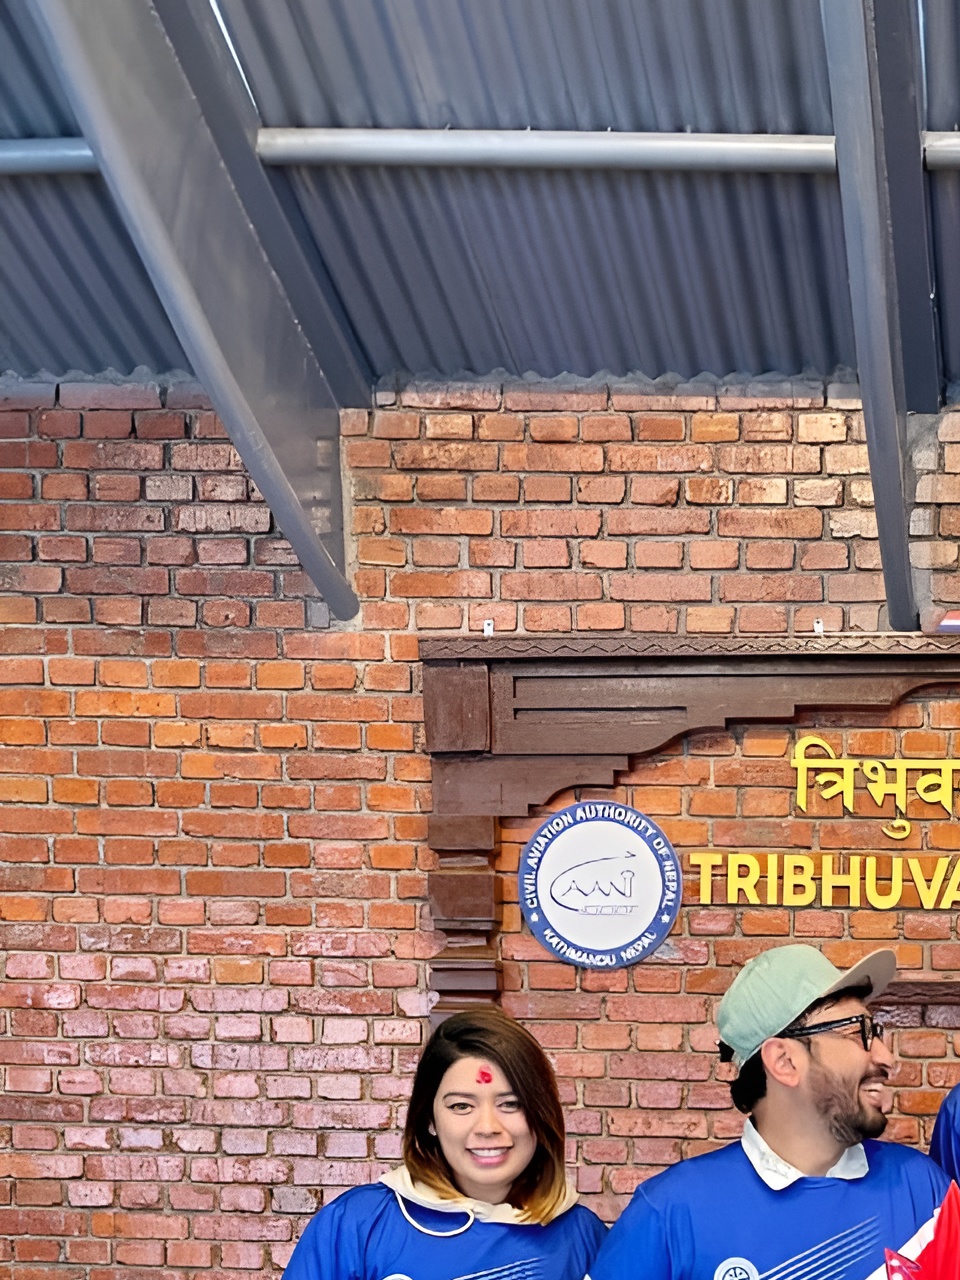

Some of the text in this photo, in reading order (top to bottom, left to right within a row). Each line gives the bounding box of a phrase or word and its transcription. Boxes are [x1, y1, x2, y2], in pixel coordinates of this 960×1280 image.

[526, 811, 574, 870] AVIATION
[575, 804, 656, 838] AUTHORITY
[523, 869, 538, 909] CIVIL
